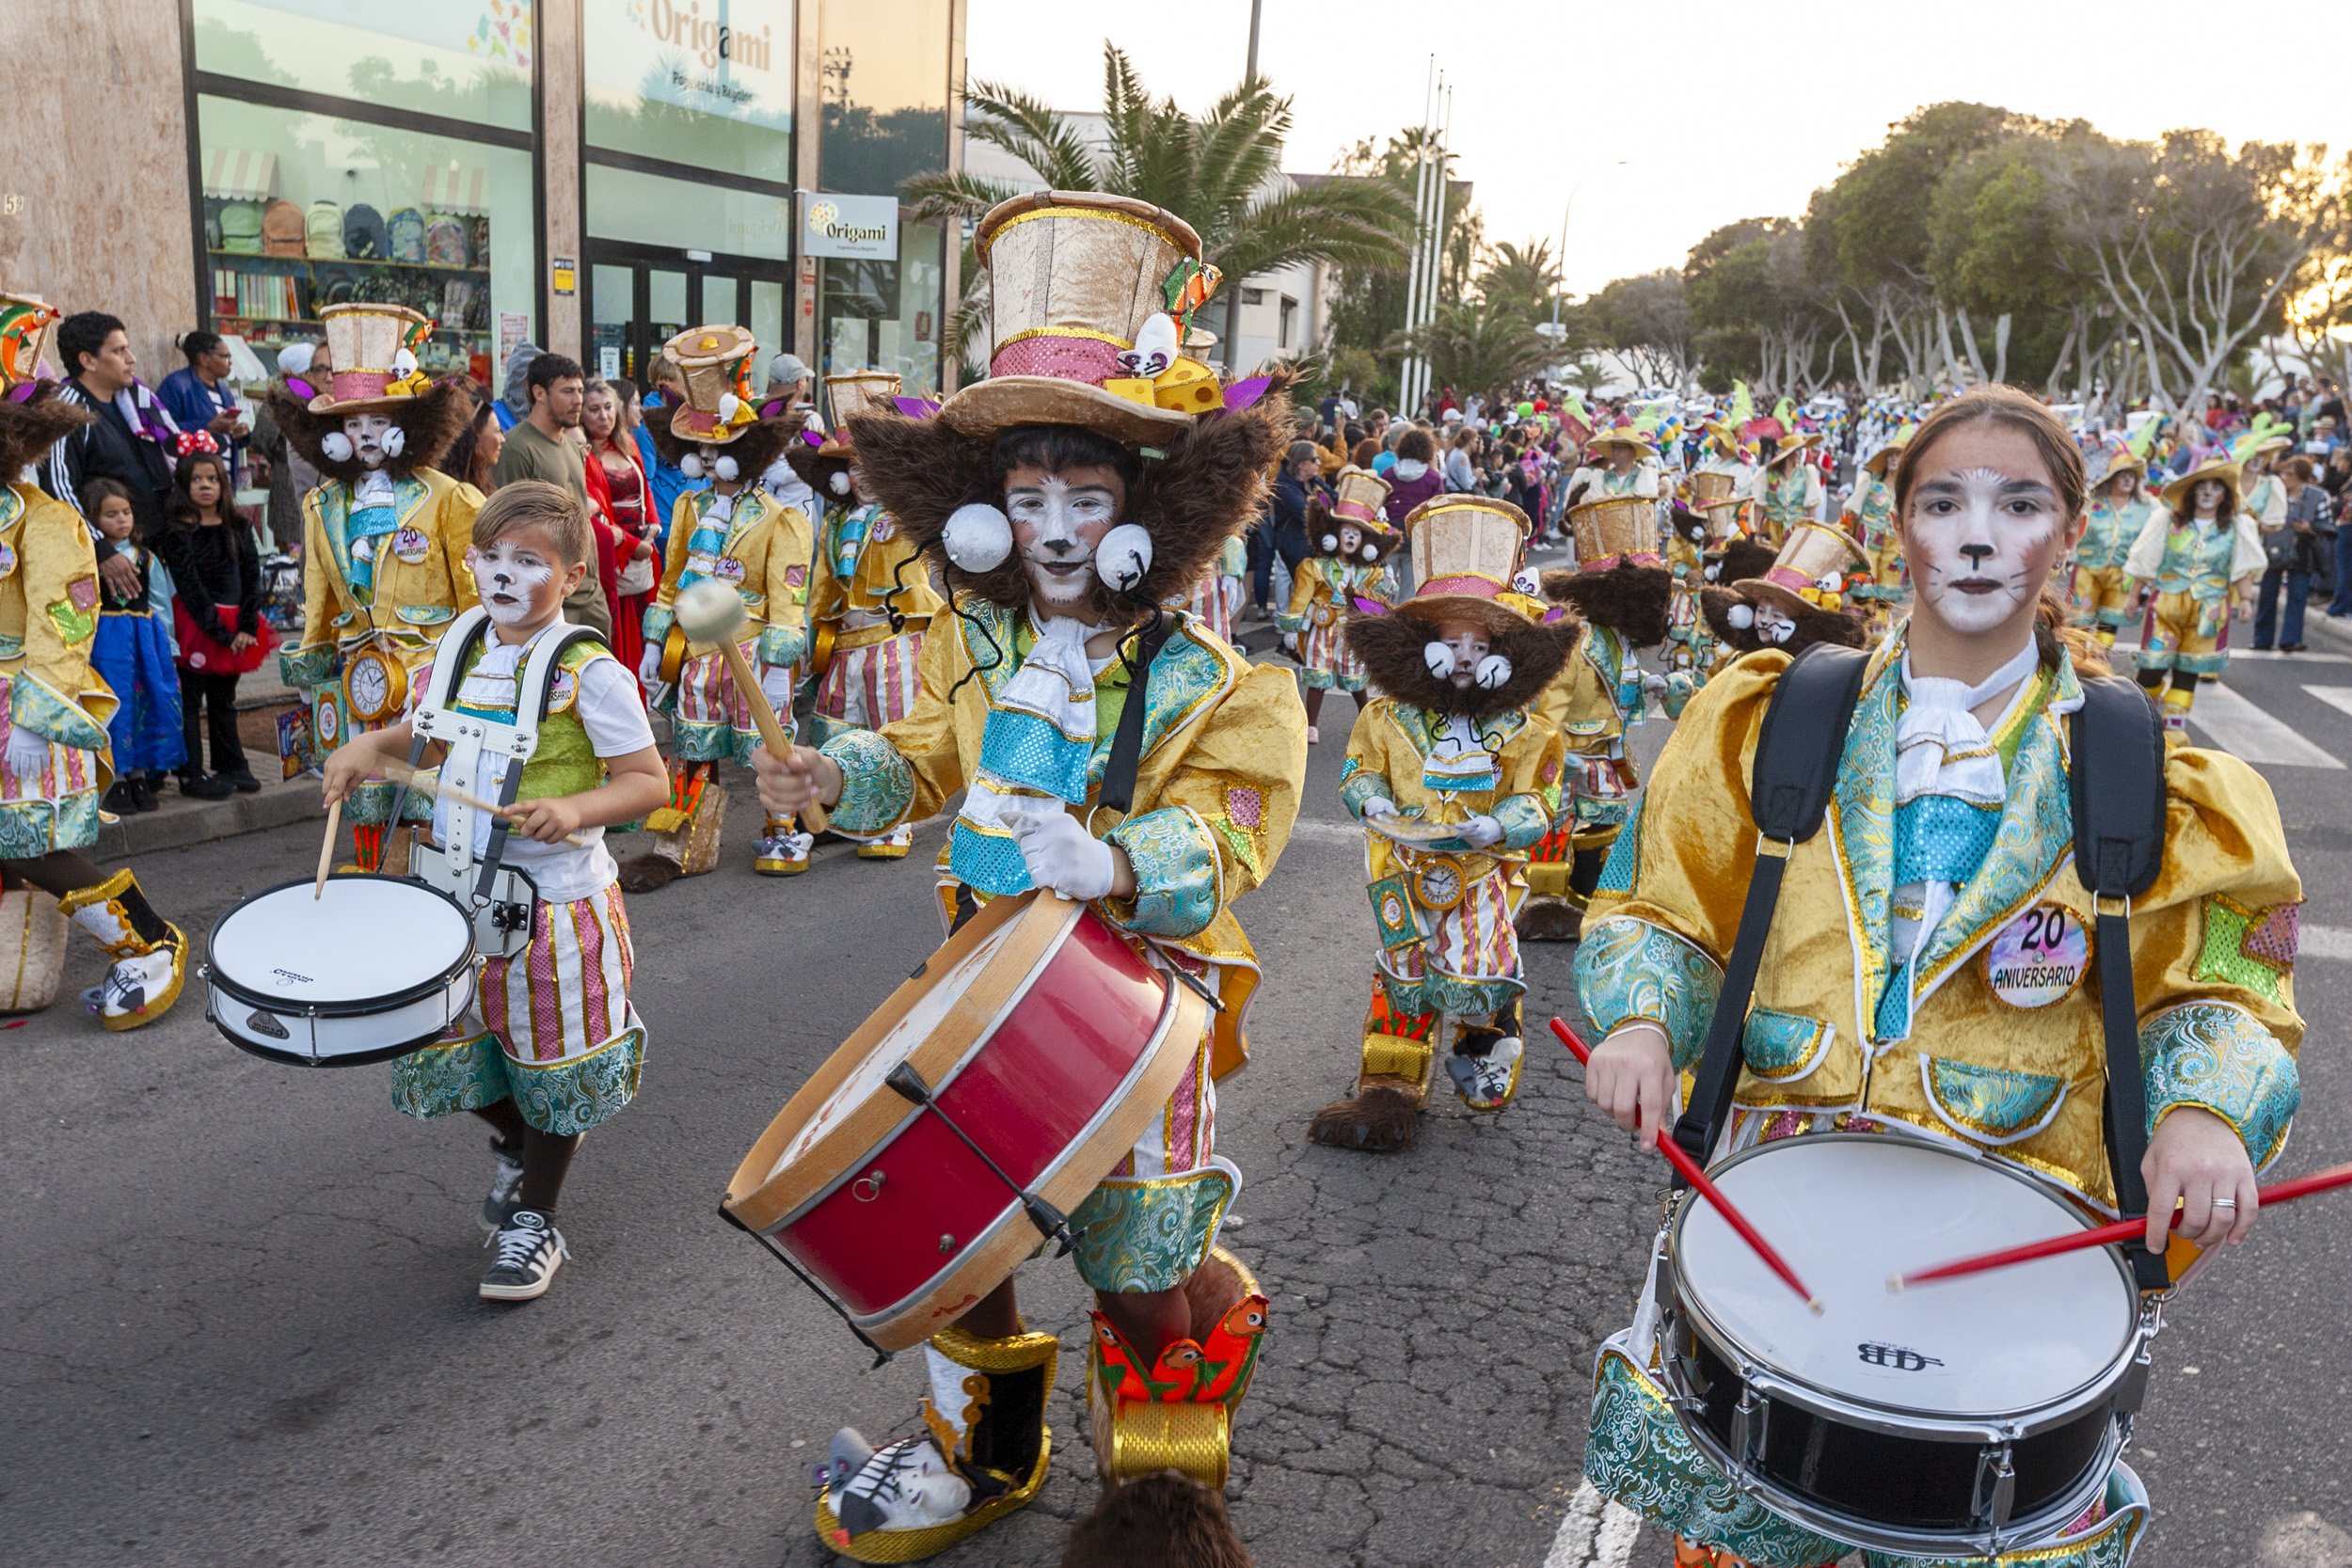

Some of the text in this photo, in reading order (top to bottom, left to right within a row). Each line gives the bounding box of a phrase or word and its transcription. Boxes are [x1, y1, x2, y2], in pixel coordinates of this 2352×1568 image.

[651, 0, 770, 71] Origami
[827, 223, 885, 243] Origami
[401, 528, 417, 543] 20
[725, 557, 739, 570] 20
[2020, 908, 2066, 951] 20
[1994, 965, 2075, 990] ANIVERSARIO
